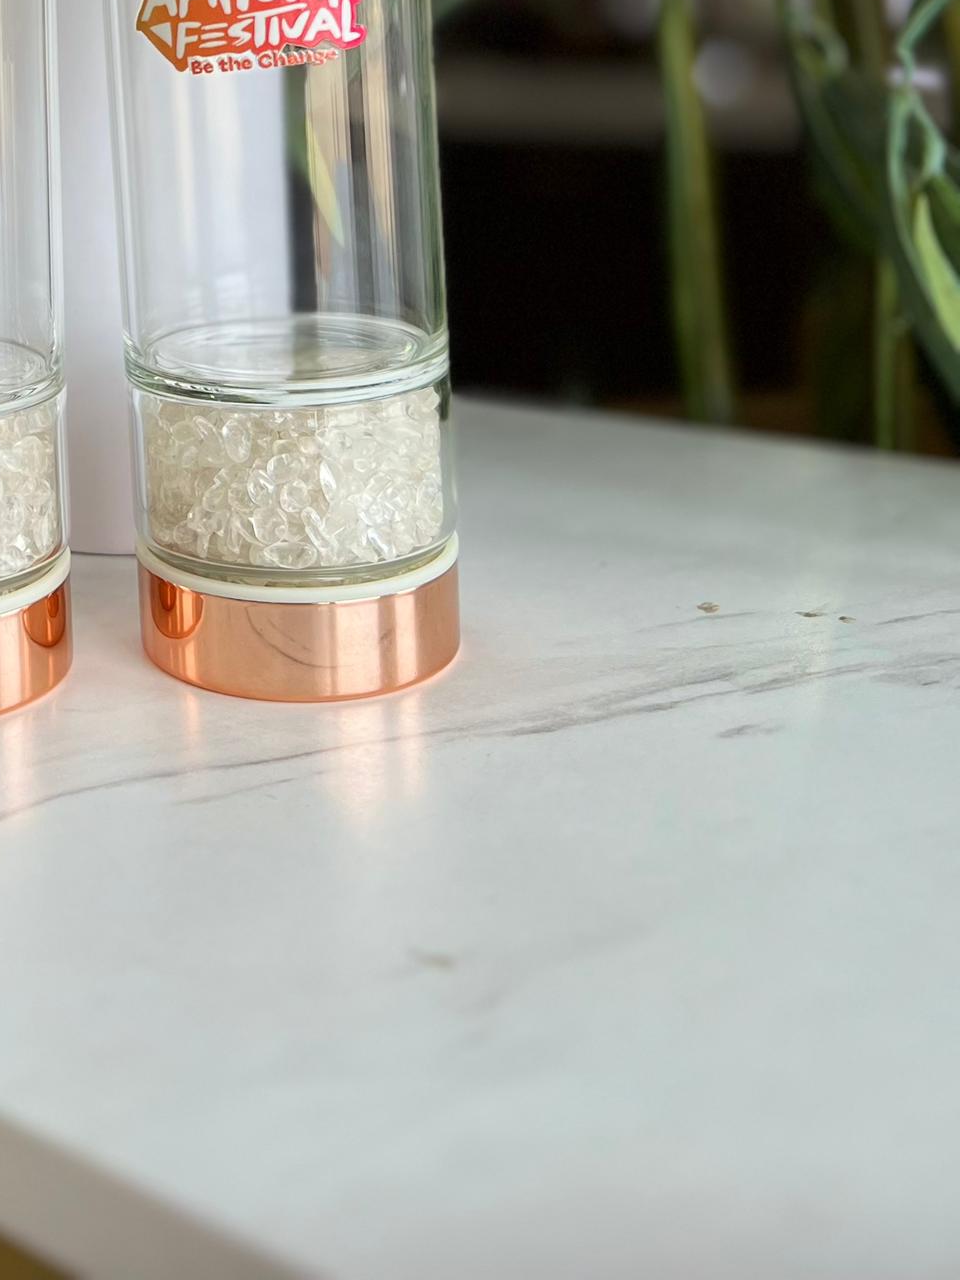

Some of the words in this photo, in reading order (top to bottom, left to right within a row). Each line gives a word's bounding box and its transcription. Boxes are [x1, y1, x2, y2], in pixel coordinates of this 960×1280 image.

[190, 59, 214, 76] Be
[218, 56, 253, 73] the
[257, 48, 338, 70] Change
